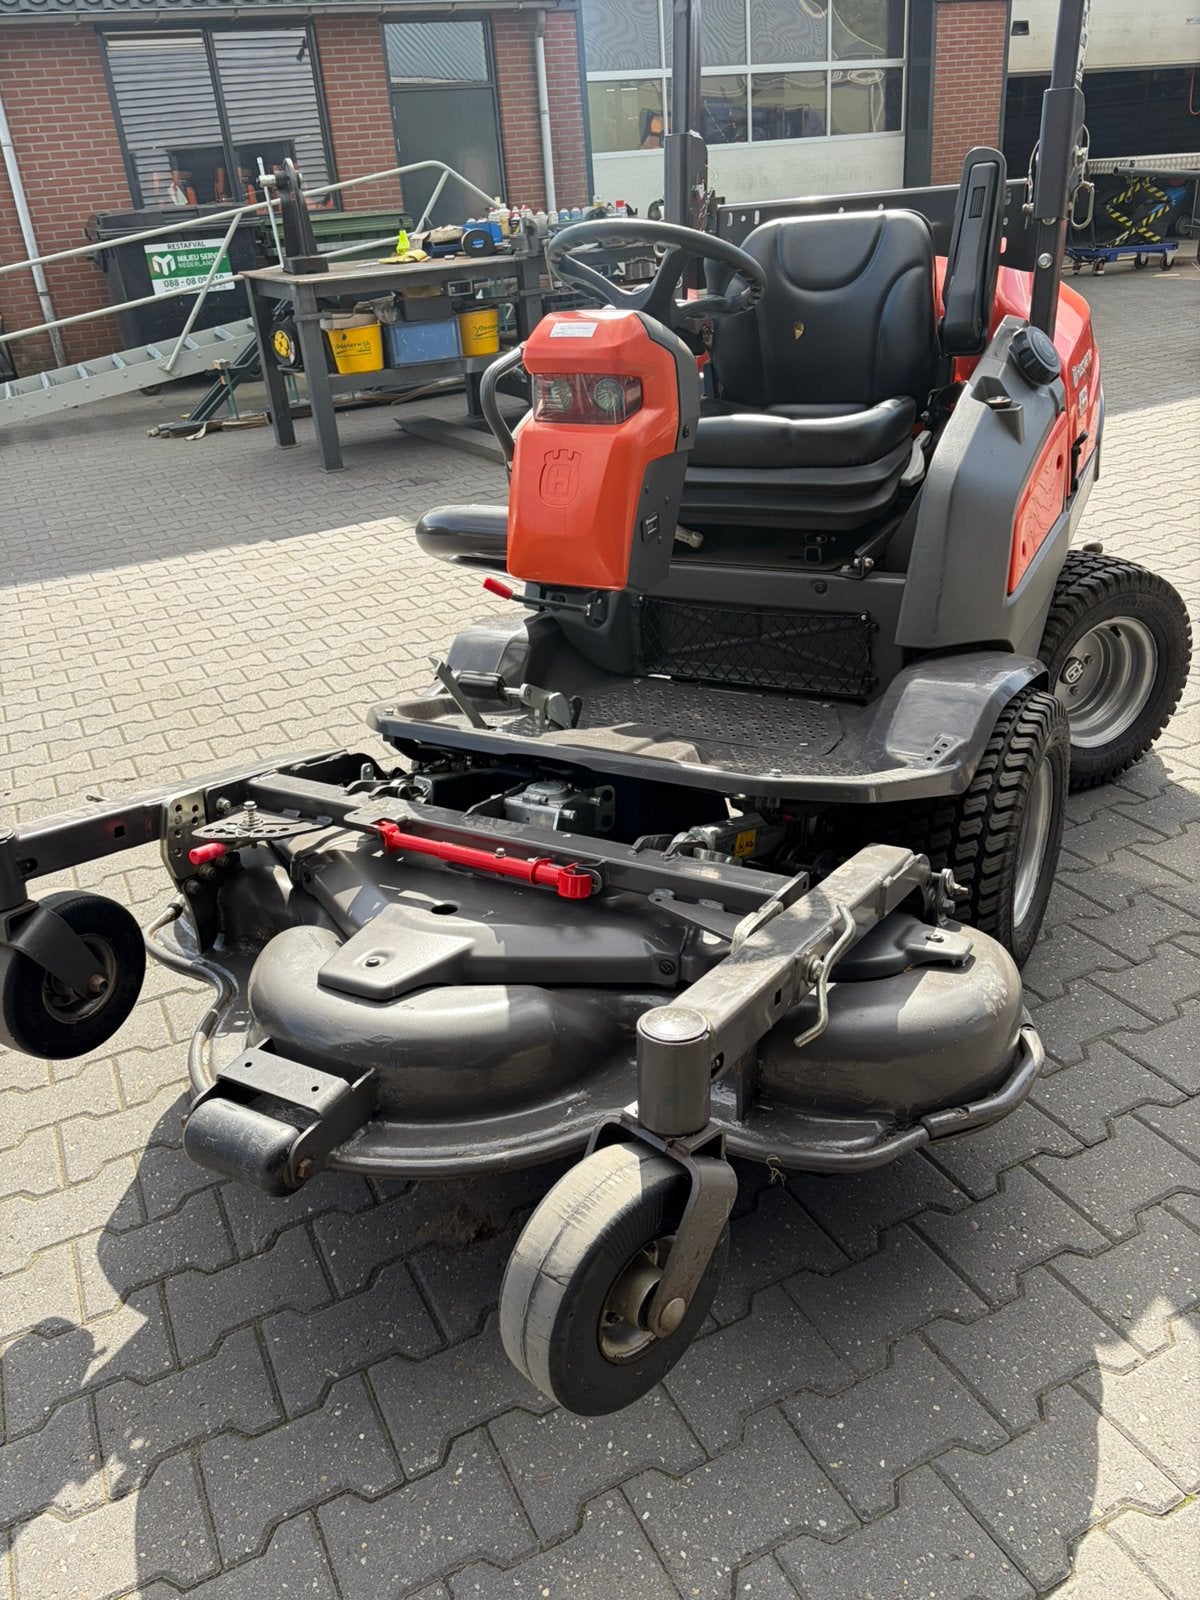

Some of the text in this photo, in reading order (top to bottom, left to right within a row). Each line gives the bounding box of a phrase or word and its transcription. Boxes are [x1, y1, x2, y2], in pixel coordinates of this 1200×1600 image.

[167, 241, 206, 250] RESTAFVAL
[177, 253, 200, 262] MILIEU
[163, 279, 180, 288] 088
[186, 277, 197, 285] 08
